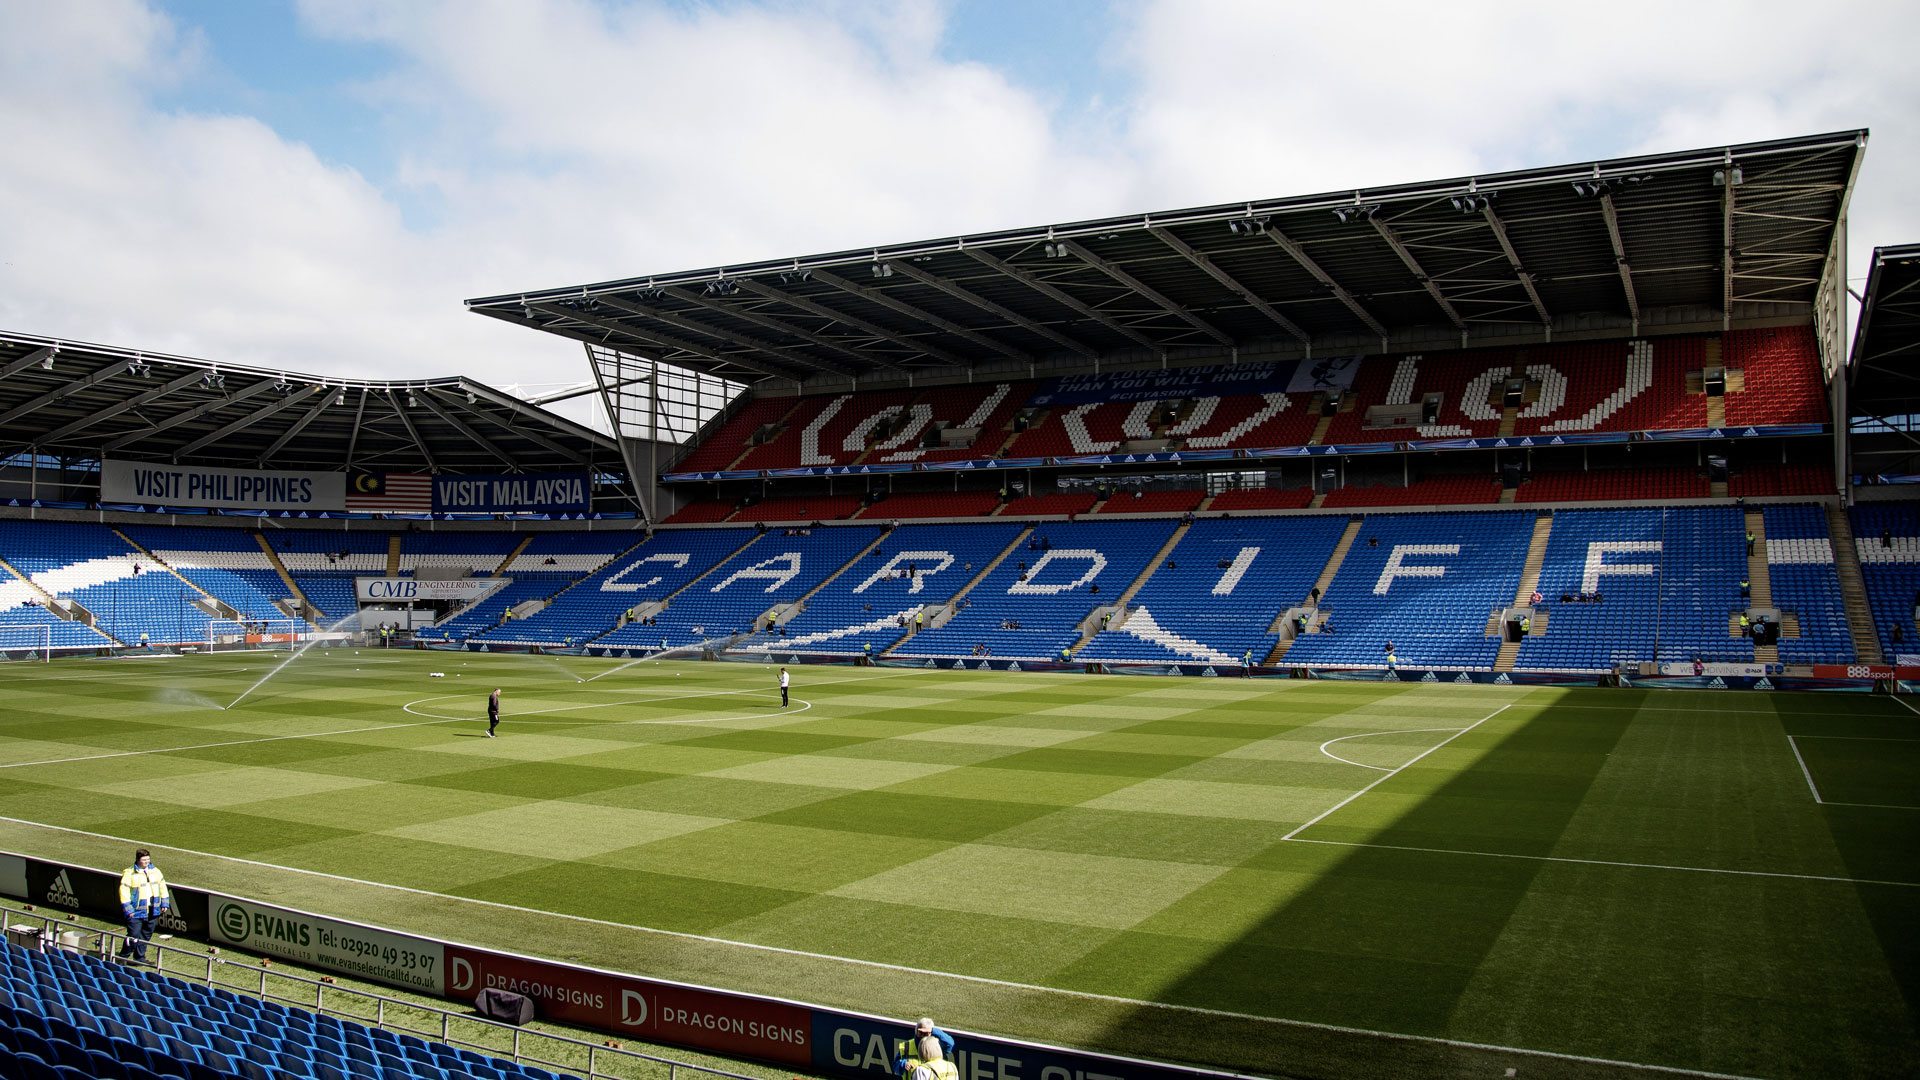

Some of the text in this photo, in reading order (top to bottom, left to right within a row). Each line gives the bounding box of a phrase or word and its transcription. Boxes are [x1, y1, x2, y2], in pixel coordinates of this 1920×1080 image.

[1057, 369, 1276, 393] THAN YOU WILL KNOW
[1060, 360, 1279, 384] CITY LOVES YOU MORE
[134, 469, 312, 503] VISIT PHILIPPINES
[439, 478, 584, 506] VISIT MALAYSIA
[368, 581, 418, 598] CMB
[1680, 666, 1740, 675] WEHDIVING
[1847, 666, 1895, 679] 888sport
[46, 890, 80, 909] adidas
[157, 915, 188, 932] didas
[254, 912, 311, 947] EVANS
[254, 939, 311, 960] ELECTRICAL LTD
[316, 927, 435, 973] Tel: 02920 49 33 07
[317, 953, 435, 989] www.evanselectricalltd.co.uk
[486, 973, 604, 1009] DRAGON SIGNS
[663, 1007, 805, 1045] DRAGON SIGNS
[833, 1027, 1022, 1080] CAIFF
